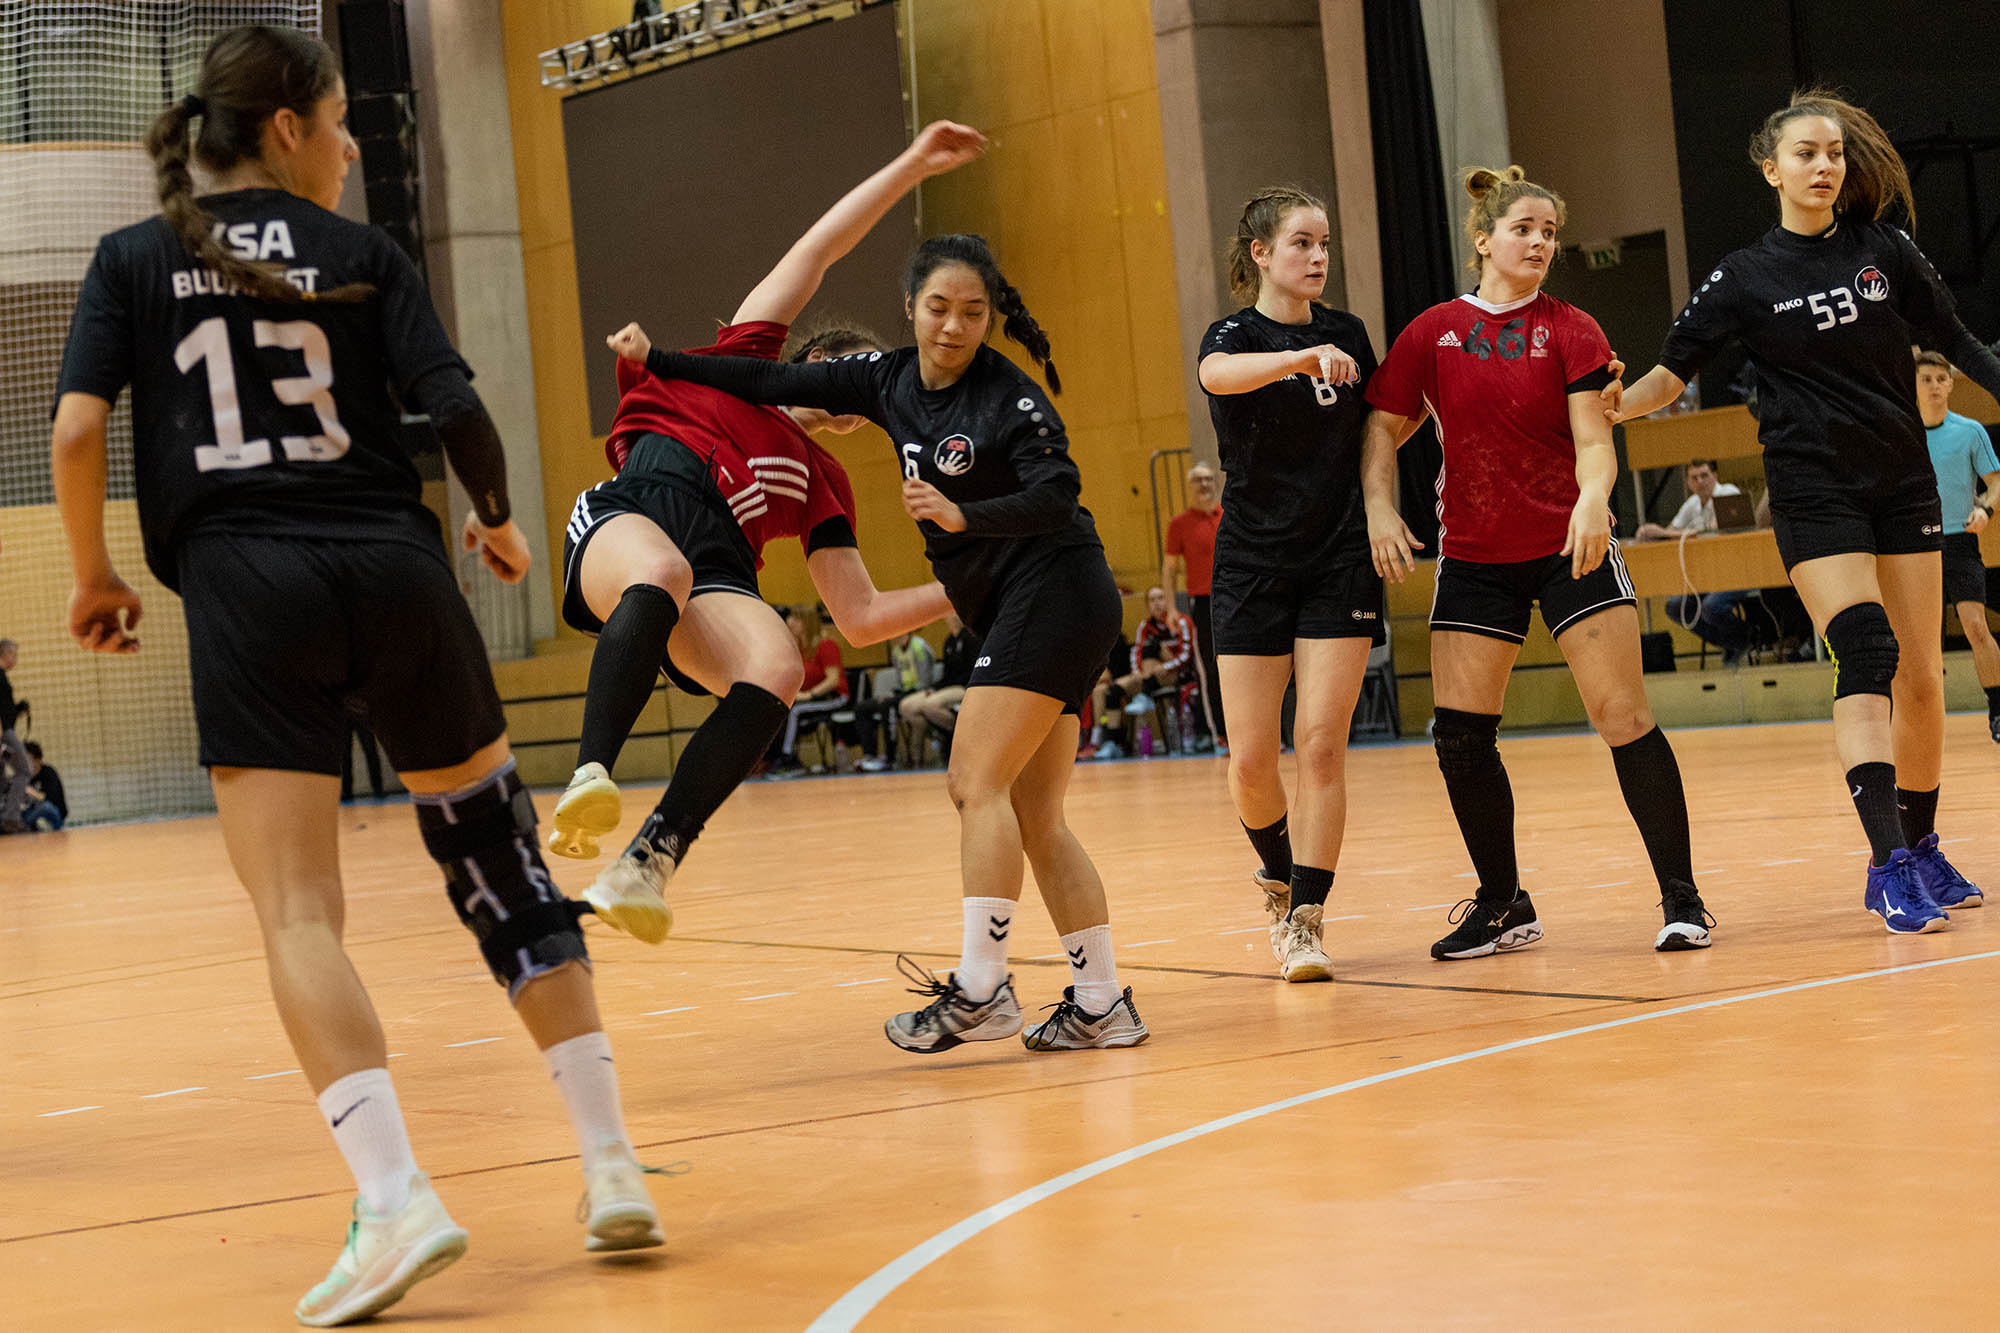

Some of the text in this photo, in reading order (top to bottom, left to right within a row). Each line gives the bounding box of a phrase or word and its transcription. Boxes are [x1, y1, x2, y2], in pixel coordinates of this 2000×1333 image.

[211, 220, 296, 260] SA
[1773, 287, 1859, 331] JAKO 53
[1461, 318, 1526, 361] 46
[174, 317, 352, 473] 13
